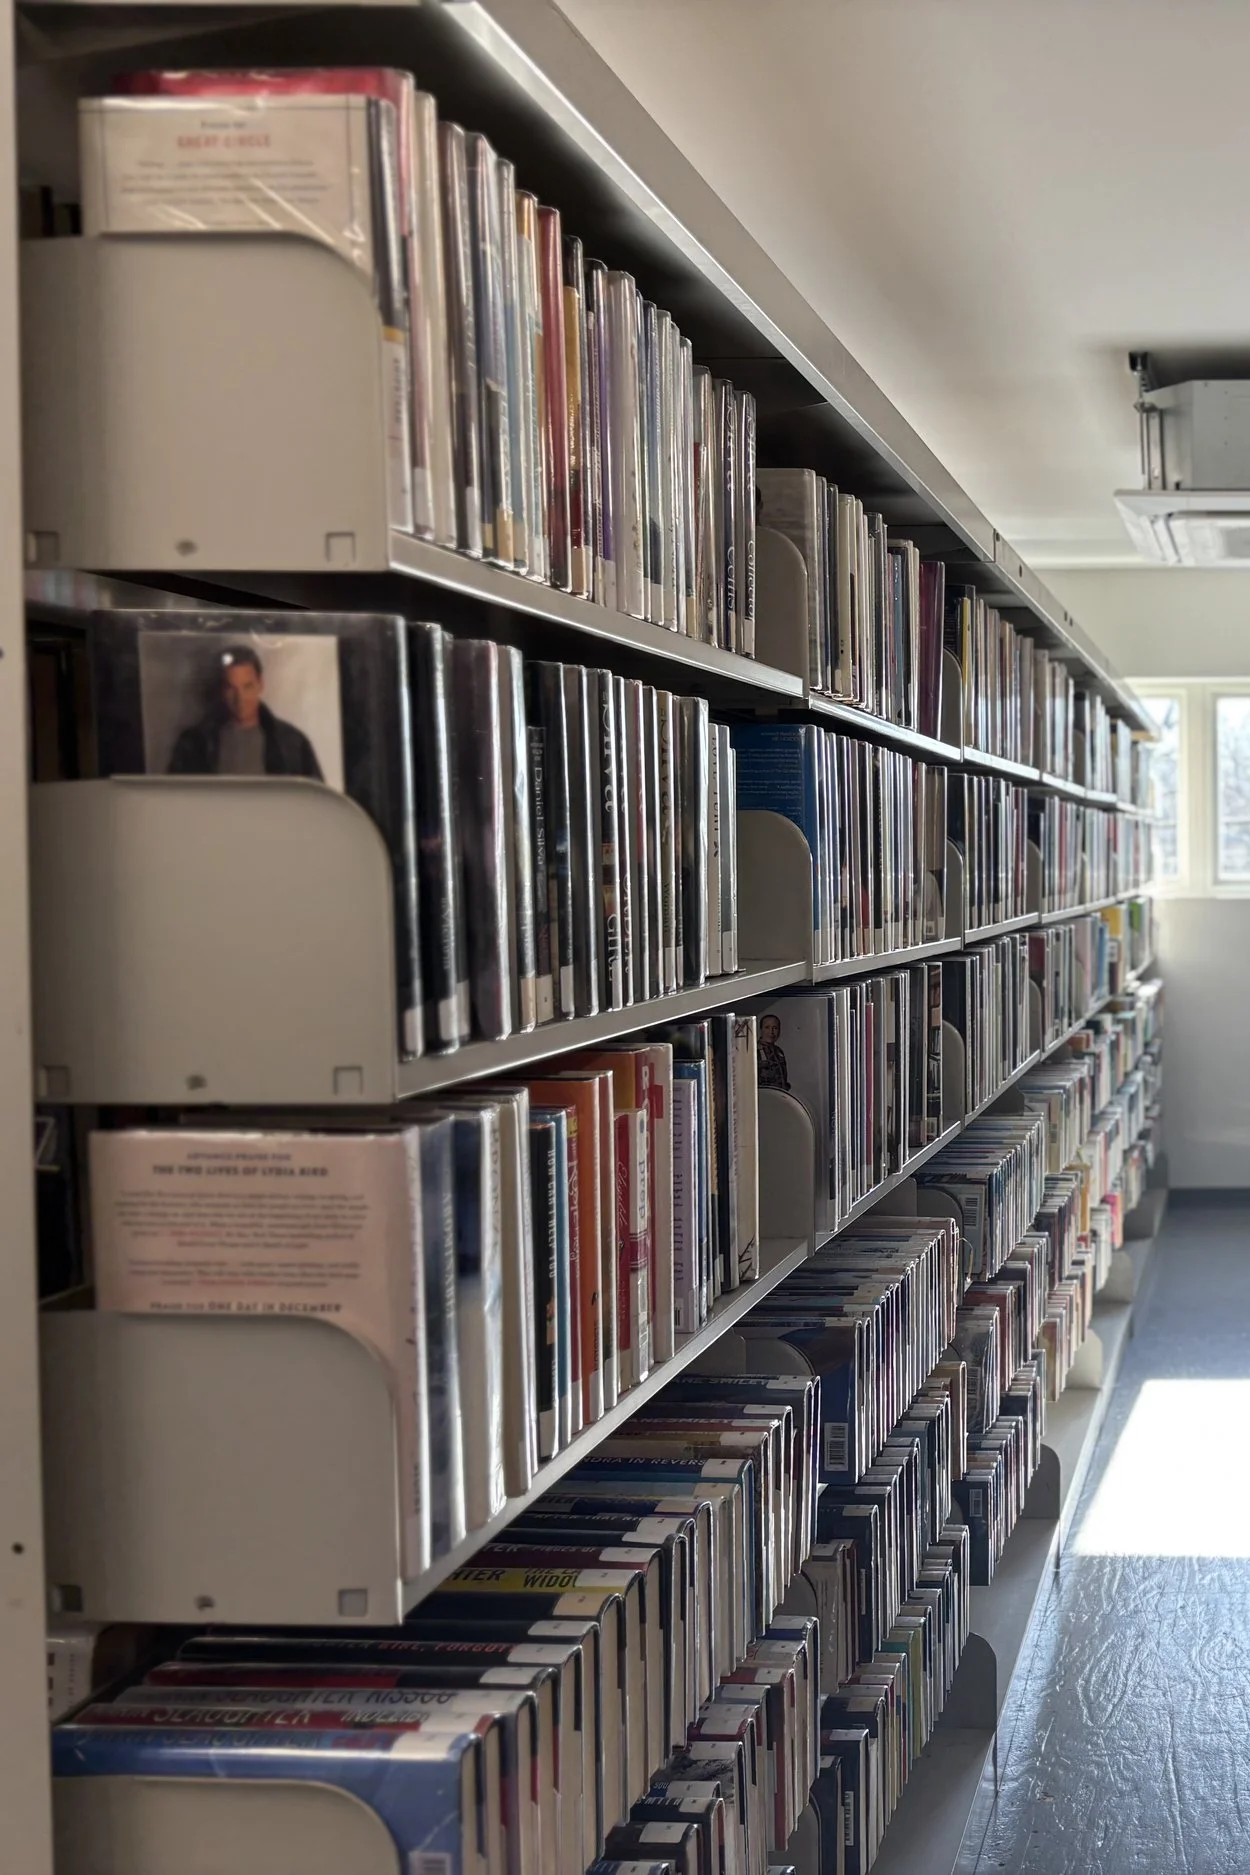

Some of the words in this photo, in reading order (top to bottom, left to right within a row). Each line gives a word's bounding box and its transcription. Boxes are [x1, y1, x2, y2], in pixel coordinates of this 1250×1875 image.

[535, 767, 544, 820] Daniel
[536, 828, 545, 867] Silva
[607, 913, 619, 983] GIRL
[152, 1165, 175, 1177] THE
[177, 1165, 204, 1177] TWO
[206, 1166, 240, 1177] LIVES
[242, 1166, 259, 1177] OF
[261, 1166, 296, 1177] LYDIA
[300, 1166, 330, 1177] BIRD
[548, 1150, 557, 1176] HOW
[548, 1183, 557, 1208] CAN
[638, 1160, 647, 1220] prep
[549, 1218, 557, 1247] HELP
[208, 1301, 233, 1311] ONE
[236, 1302, 260, 1311] DAY
[278, 1301, 343, 1313] DECEMBER
[152, 1707, 311, 1725] SLAUGHTER
